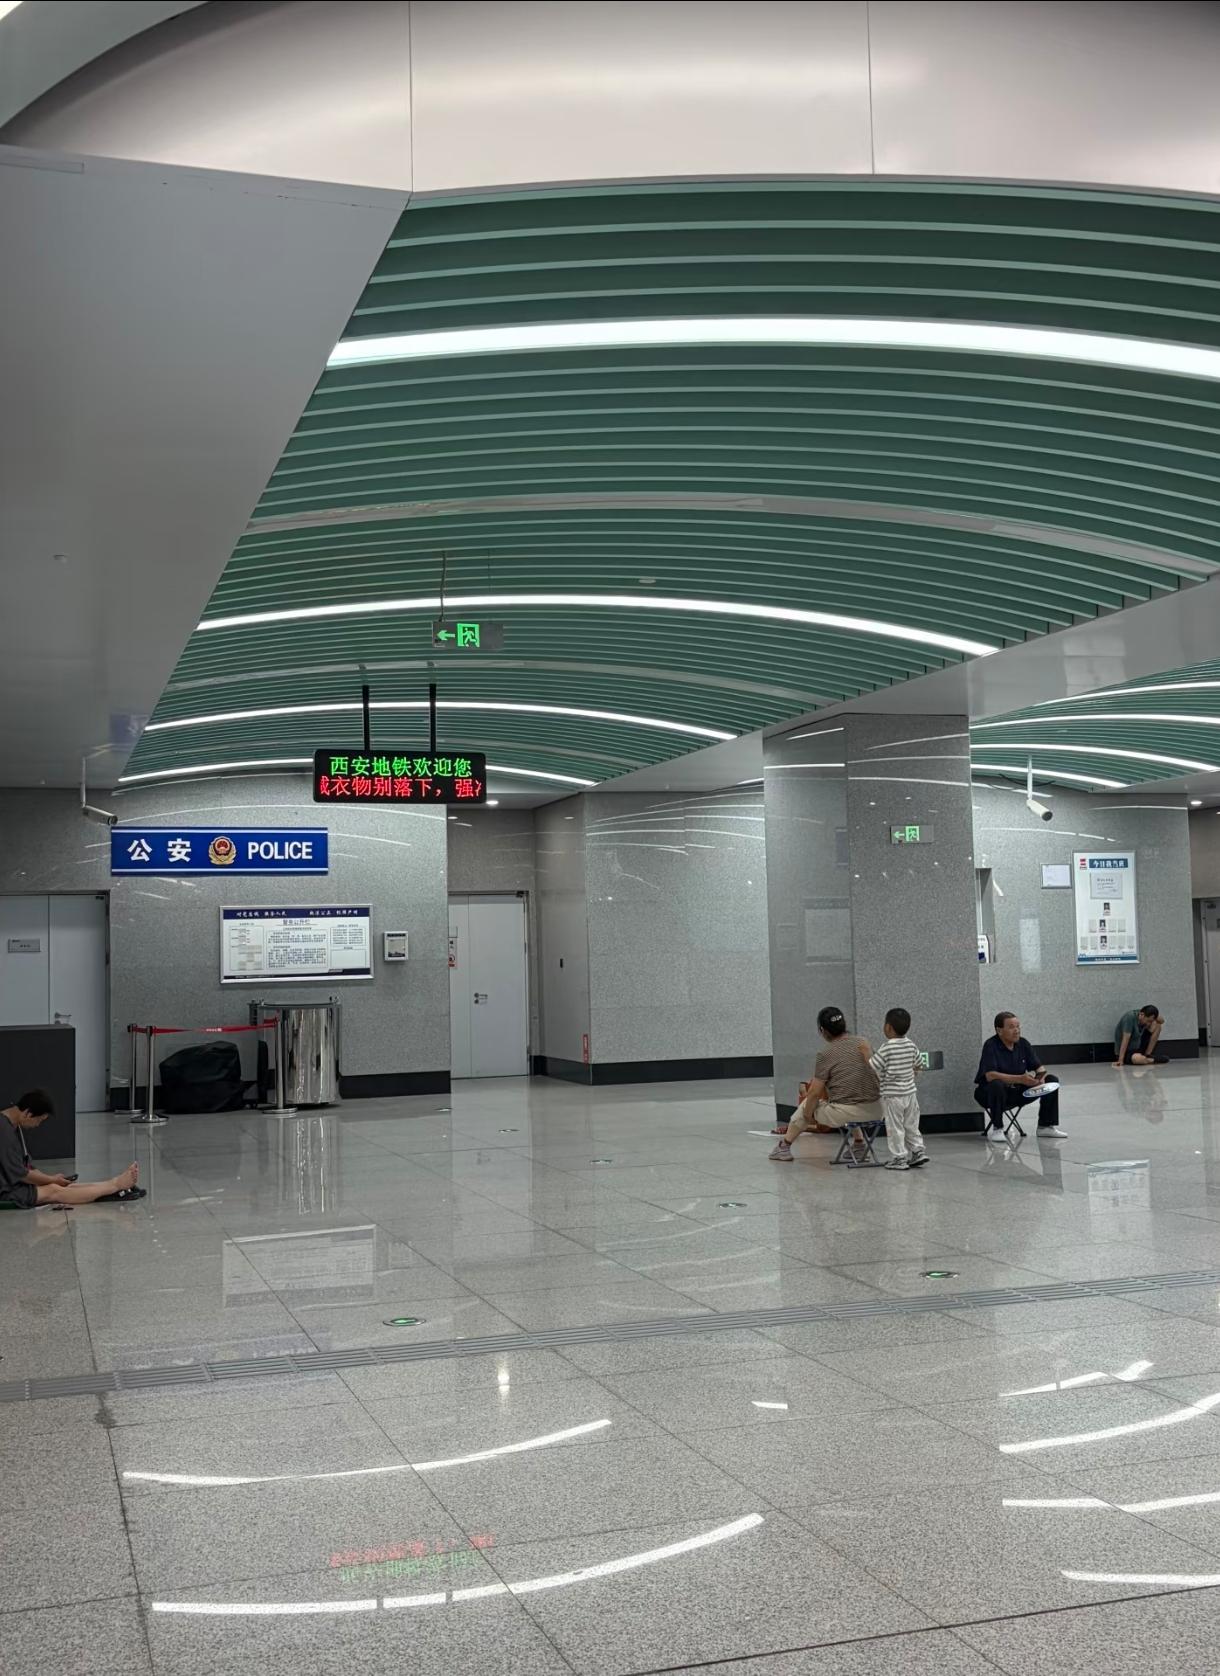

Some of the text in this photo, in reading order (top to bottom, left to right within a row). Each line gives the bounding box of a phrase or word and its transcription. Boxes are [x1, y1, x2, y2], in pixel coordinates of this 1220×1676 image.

[329, 756, 472, 777] 西安地铁欢迎您
[127, 838, 313, 862] 公安 POLICE
